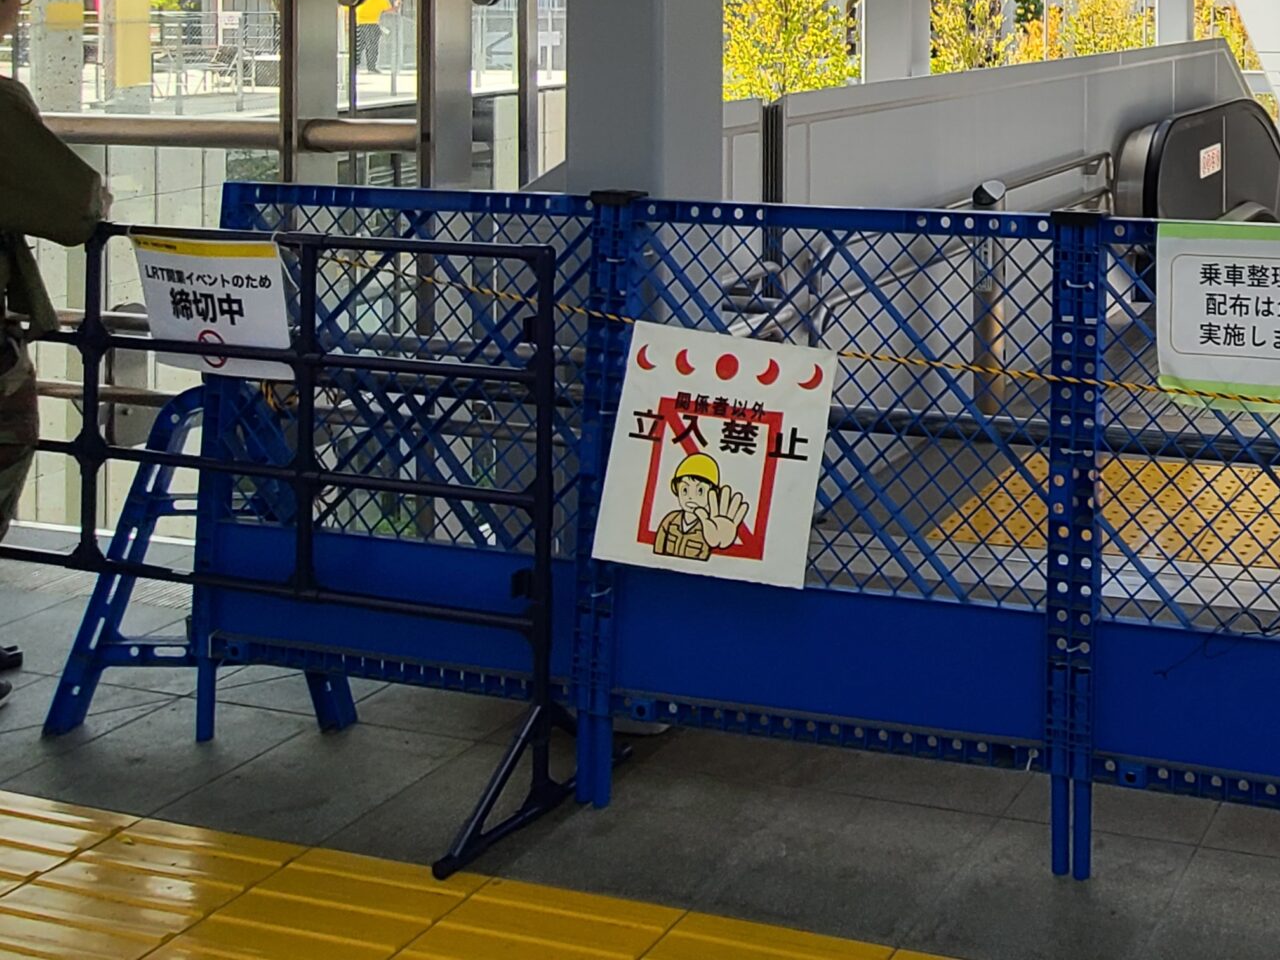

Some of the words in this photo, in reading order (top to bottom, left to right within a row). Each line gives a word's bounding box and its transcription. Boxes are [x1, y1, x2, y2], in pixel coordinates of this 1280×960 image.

[169, 287, 245, 326] 締切中
[674, 391, 766, 422] 関係者以外
[628, 409, 809, 461] 立入禁止
